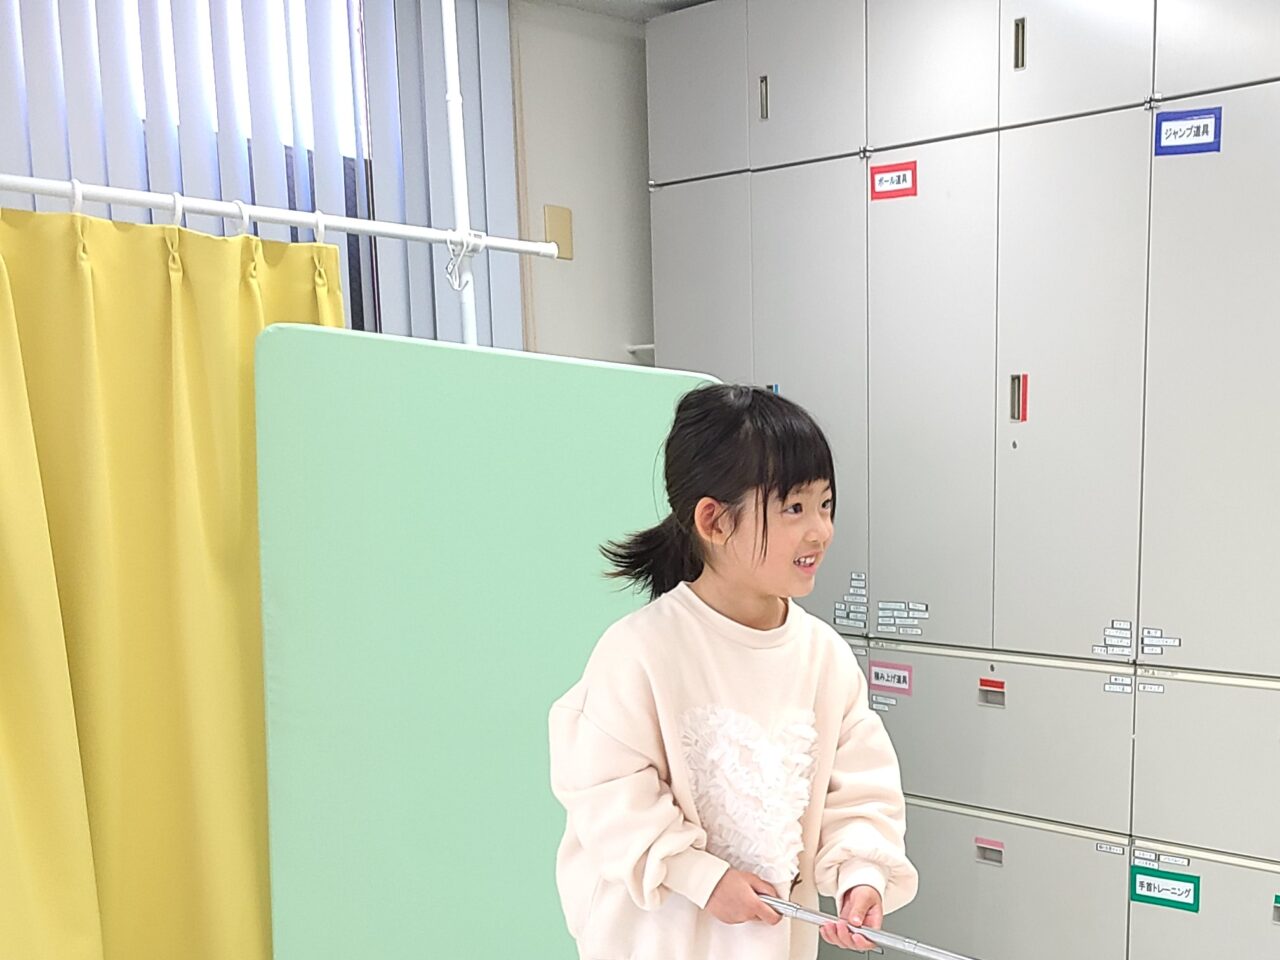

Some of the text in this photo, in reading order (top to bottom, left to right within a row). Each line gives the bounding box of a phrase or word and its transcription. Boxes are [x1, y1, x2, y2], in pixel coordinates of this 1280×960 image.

[1164, 123, 1210, 141] ジャンプ道具
[1138, 880, 1192, 898] 手首トレーニング
